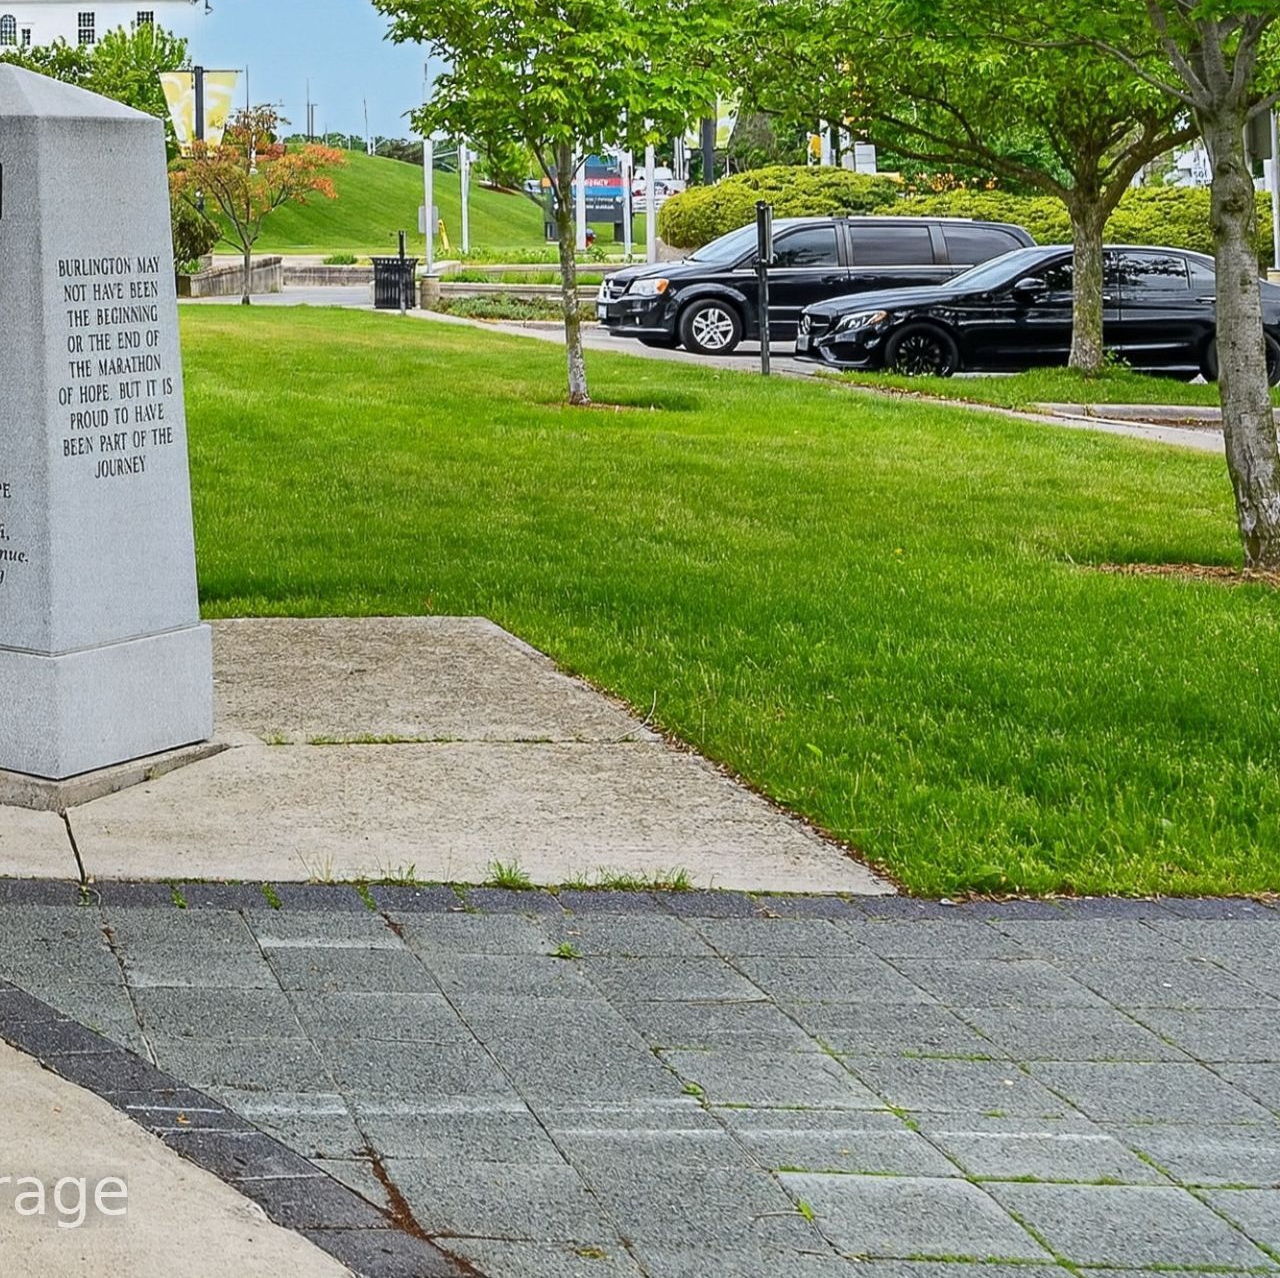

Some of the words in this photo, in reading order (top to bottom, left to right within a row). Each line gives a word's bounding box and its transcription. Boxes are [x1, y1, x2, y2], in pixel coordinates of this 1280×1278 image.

[58, 257, 131, 277] BURLINGTON
[137, 256, 160, 274] MAY
[64, 284, 87, 302] NOT
[93, 283, 123, 301] HAVE
[130, 281, 158, 299] BEEN
[67, 309, 90, 327] THE
[97, 304, 158, 326] BEGINNING
[67, 335, 83, 353] OR
[88, 333, 111, 351] THE
[118, 330, 141, 349] END
[146, 329, 160, 347] OF
[69, 359, 92, 379] THE
[99, 354, 161, 376] MARATHON
[59, 387, 73, 406] OF
[120, 380, 141, 400] BUT
[146, 379, 157, 397] IT
[163, 377, 172, 395] IS
[70, 409, 109, 430] PROUD
[114, 406, 128, 425] TO
[135, 403, 164, 423] HAVE
[63, 436, 93, 457] BEEN
[100, 432, 127, 452] PART
[133, 430, 146, 448] OF
[151, 427, 173, 446] THE
[95, 455, 146, 479] JOURNEY
